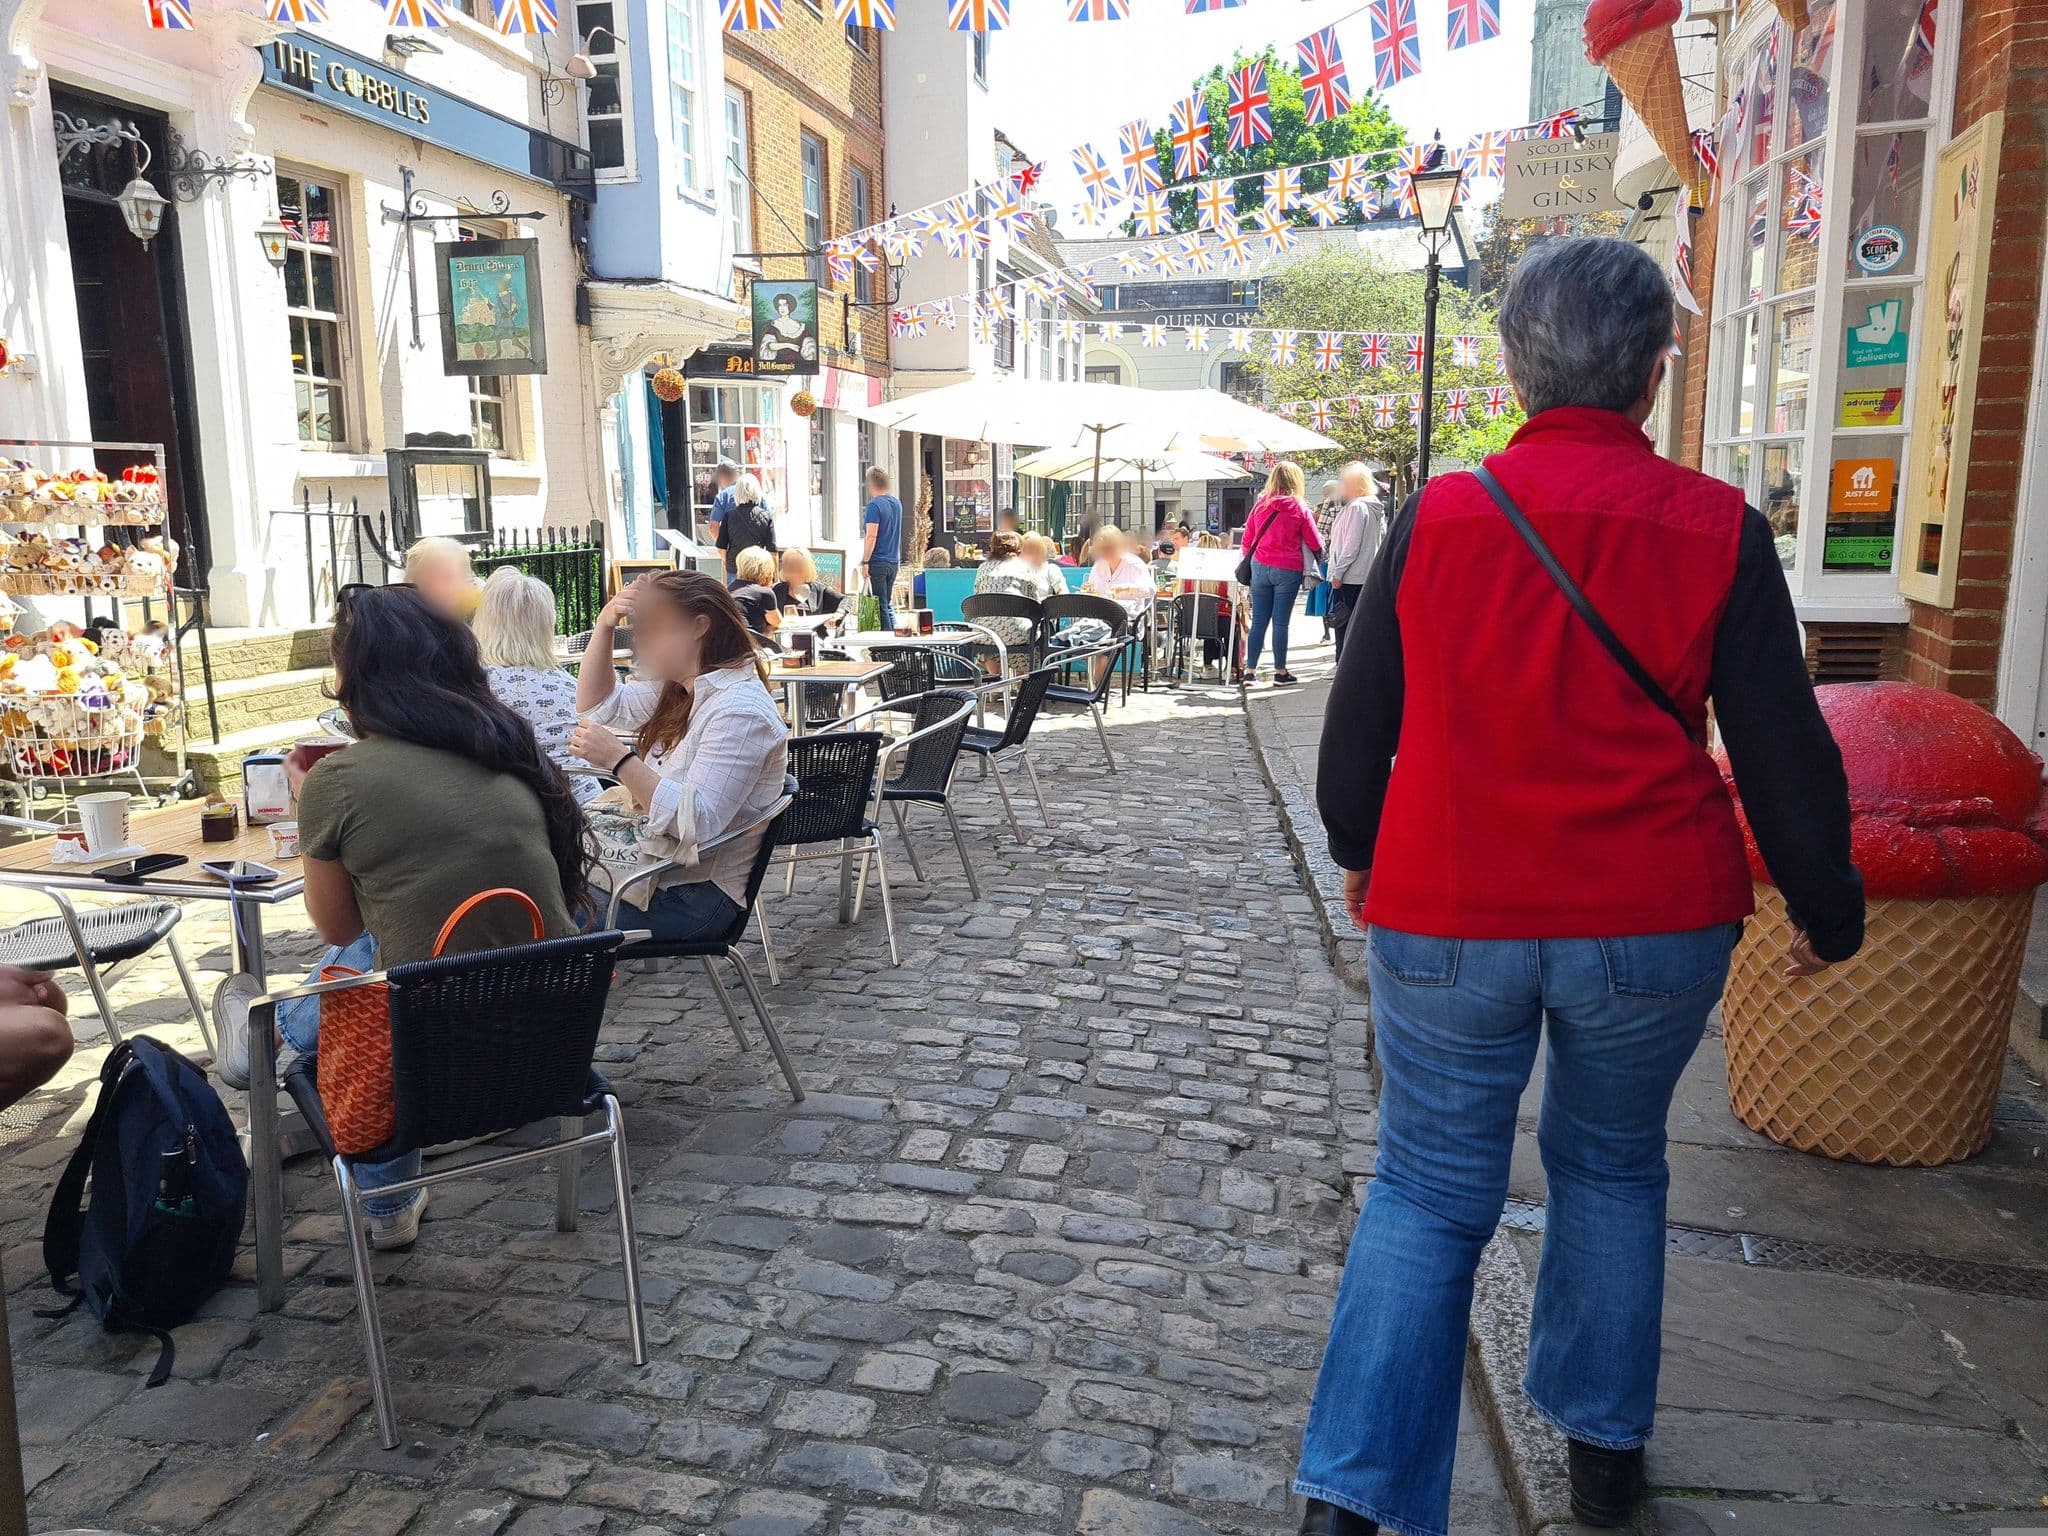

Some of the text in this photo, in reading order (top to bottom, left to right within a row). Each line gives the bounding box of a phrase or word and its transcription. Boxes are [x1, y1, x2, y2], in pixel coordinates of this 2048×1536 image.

[273, 38, 430, 124] THE COBBLES
[1526, 138, 1610, 156] SCOTSH
[1517, 157, 1615, 177] WHISKY
[1559, 174, 1582, 189] &
[1533, 188, 1598, 207] GINS
[1154, 313, 1217, 327] QUEEN
[1856, 352, 1900, 363] deliveroo
[1843, 490, 1863, 498] JUST
[1881, 551, 1889, 559] 5
